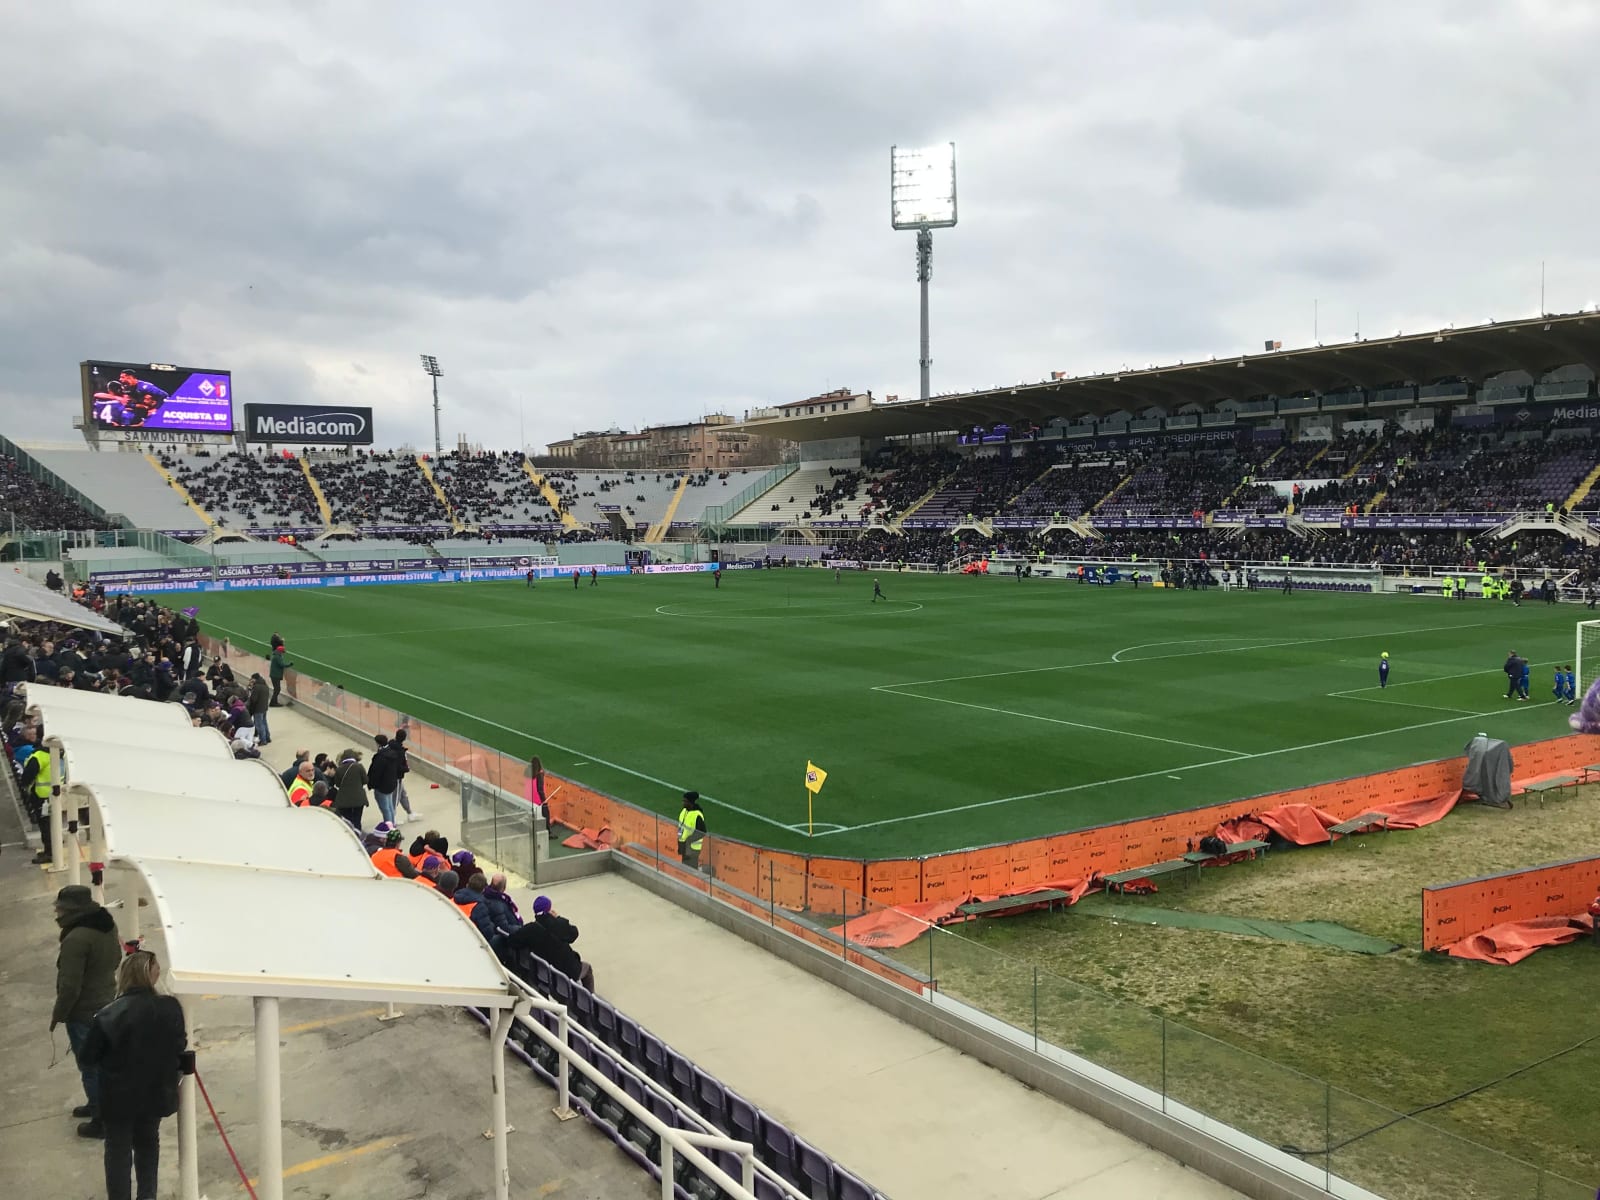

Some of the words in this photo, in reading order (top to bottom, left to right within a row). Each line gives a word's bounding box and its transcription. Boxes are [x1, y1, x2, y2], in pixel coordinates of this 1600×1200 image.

[163, 411, 212, 420] ACQUISTA
[214, 413, 227, 421] SU
[1553, 405, 1600, 420] Media
[256, 414, 360, 436] Mediacom
[124, 431, 205, 443] SAMMONTANA
[685, 564, 704, 572] Cargo
[726, 562, 755, 570] Mediacom
[219, 568, 251, 576] CASCIANA
[230, 578, 259, 587] KAPPA
[261, 577, 321, 586] FUTURFESTIVAL
[349, 574, 377, 583] KAPPA
[378, 572, 433, 582] FUTURFESTIVAL
[104, 584, 129, 592] APPA
[131, 580, 198, 591] FUTURFESTIVAL
